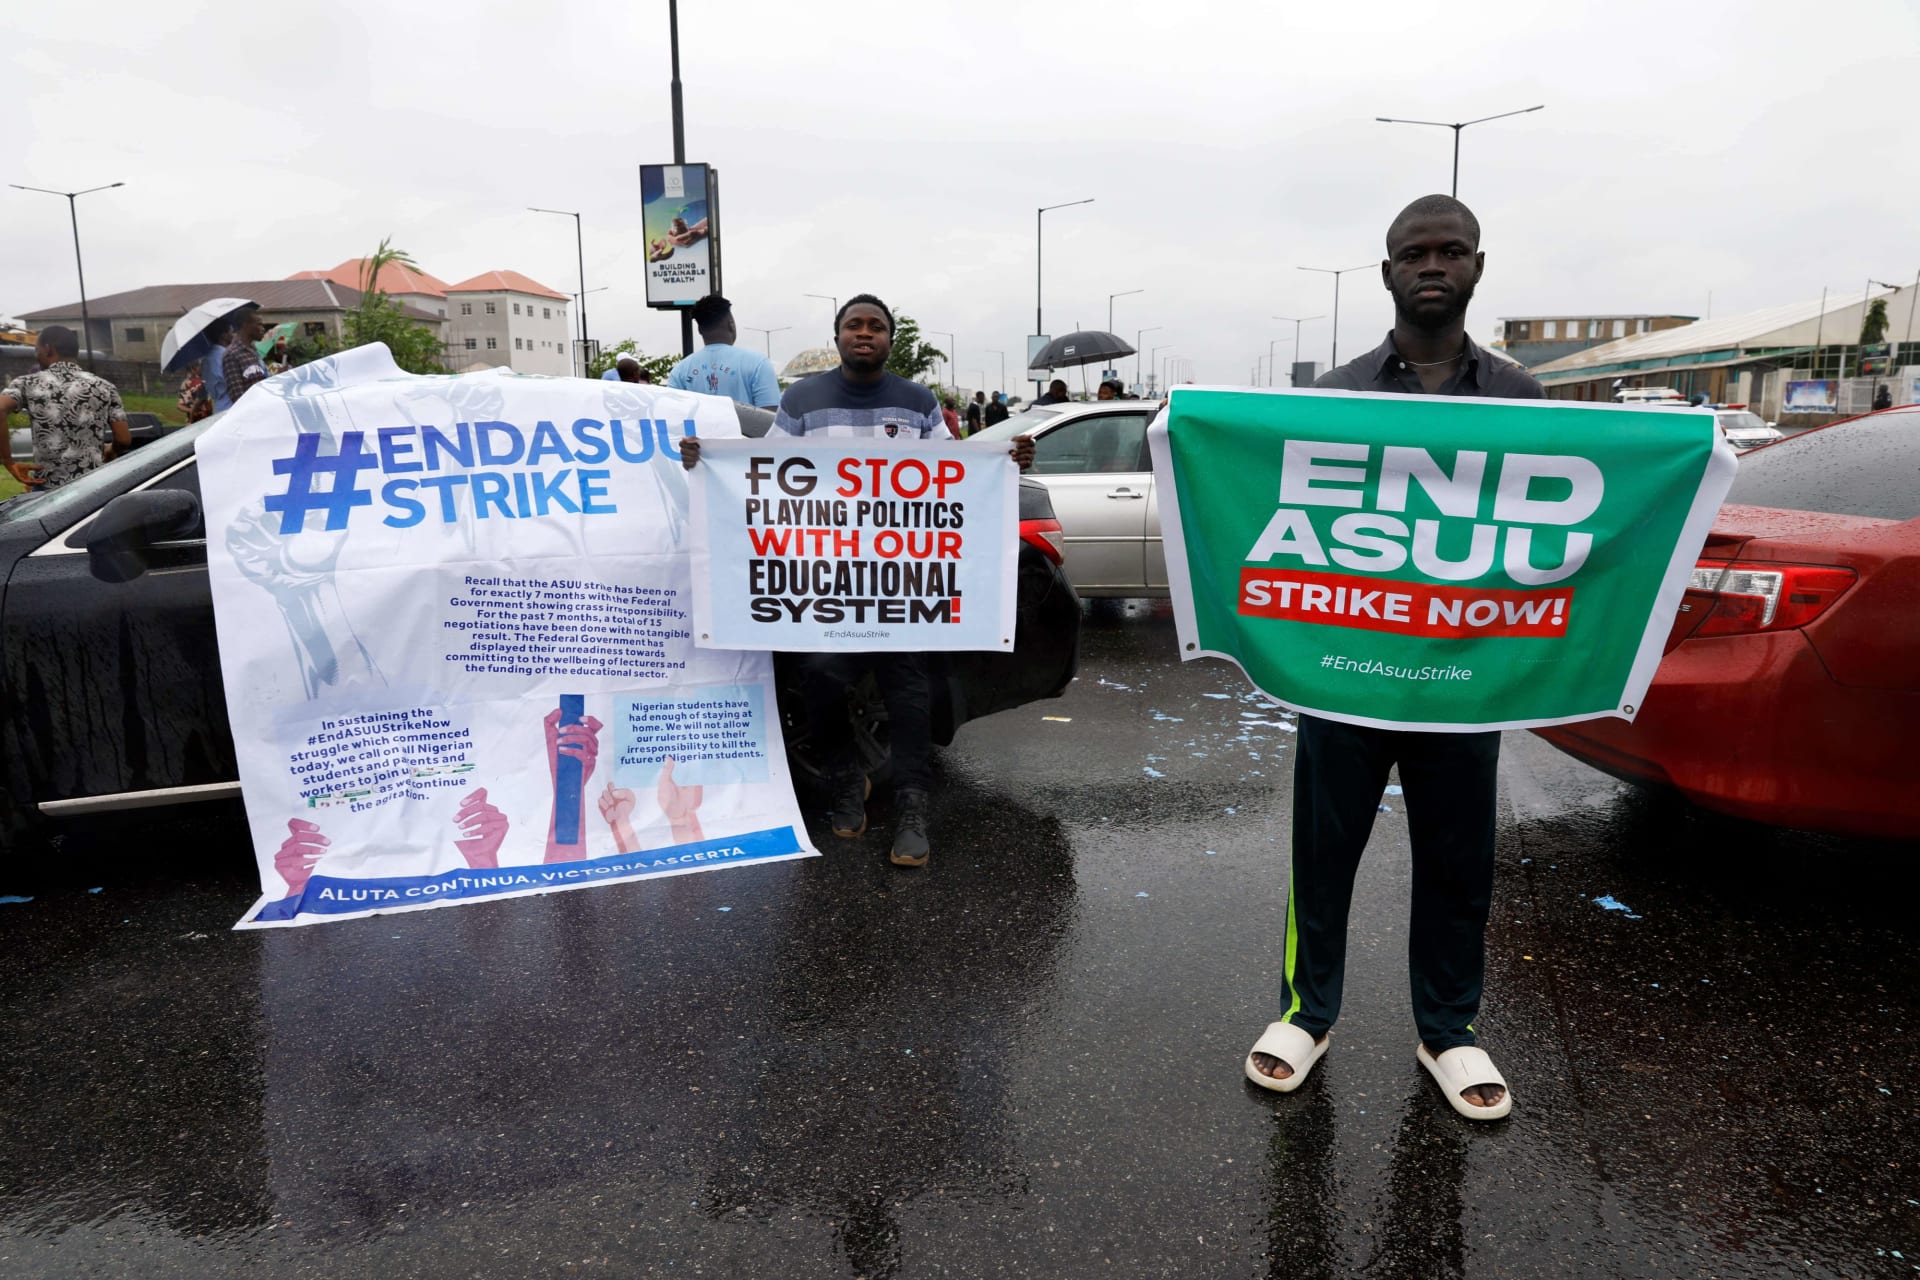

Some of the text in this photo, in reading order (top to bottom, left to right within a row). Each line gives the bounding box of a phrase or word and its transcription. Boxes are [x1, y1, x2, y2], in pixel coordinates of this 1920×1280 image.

[653, 269, 706, 277] SUSTAINABLE
[660, 262, 696, 270] BUILDING
[745, 456, 965, 498] FG STOP
[1278, 439, 1605, 526] END
[381, 467, 617, 529] STRIKE
[745, 498, 964, 529] PLAYING POLITICS
[748, 528, 963, 560] WITH OUR
[1245, 508, 1593, 586] ASUU
[465, 576, 500, 586] Recall
[503, 578, 526, 587] that
[529, 580, 548, 588] the
[550, 580, 582, 589] ASUU
[614, 585, 633, 594] has
[635, 586, 661, 596] been
[749, 559, 962, 597] EDUCATIONAL
[450, 597, 523, 609] Government
[526, 601, 573, 612] showing
[575, 603, 604, 611] crass
[470, 587, 488, 596] for
[490, 590, 532, 600] exactly
[543, 591, 585, 600] months
[631, 596, 671, 607] Federal
[1244, 578, 1564, 627] STRIKE NOW!
[477, 610, 496, 619] For
[499, 611, 518, 619] the
[520, 612, 545, 622] past
[548, 613, 554, 621] 7
[556, 613, 602, 623] months,
[612, 615, 635, 625] total
[637, 618, 648, 626] of
[650, 619, 662, 627] 15
[750, 597, 961, 623] SYSTEM!
[444, 620, 520, 631] negotiations
[522, 623, 549, 631] have
[551, 623, 577, 632] been
[580, 624, 607, 633] done
[609, 626, 632, 635] with
[647, 629, 690, 639] tangible
[472, 632, 664, 647] result. The Federal Government has
[823, 630, 890, 639] #EndAsuuStrike
[470, 642, 665, 658] displayed their unreadiness towards
[445, 653, 685, 669] committing to the wellbeing of lecturers and
[465, 664, 668, 678] the funding of the educational sector.
[1320, 653, 1473, 682] #EndAsuuStrike
[629, 710, 752, 722] had enough of staying at
[632, 700, 749, 712] Nigerian students have
[322, 708, 433, 730] In sustaining the
[632, 720, 750, 733] home. We will not allow
[307, 720, 450, 746] #EndASUUStrikeNow
[636, 730, 747, 743] our rulers to use their
[290, 728, 469, 762] struggle which commenced
[627, 740, 756, 754] irresponsibility to kill the
[290, 741, 473, 775] today, we call on all Nigerian
[620, 756, 654, 765] future
[715, 750, 764, 760] students.
[303, 752, 465, 785] students and parents and
[300, 780, 356, 798] workers
[358, 777, 371, 785] to
[374, 769, 399, 785] join
[379, 778, 466, 793] as we continue
[350, 801, 372, 813] the
[376, 789, 430, 806] agitation.
[319, 847, 745, 902] ALUTA CONTINUA, VICTORIA ASCERTA
